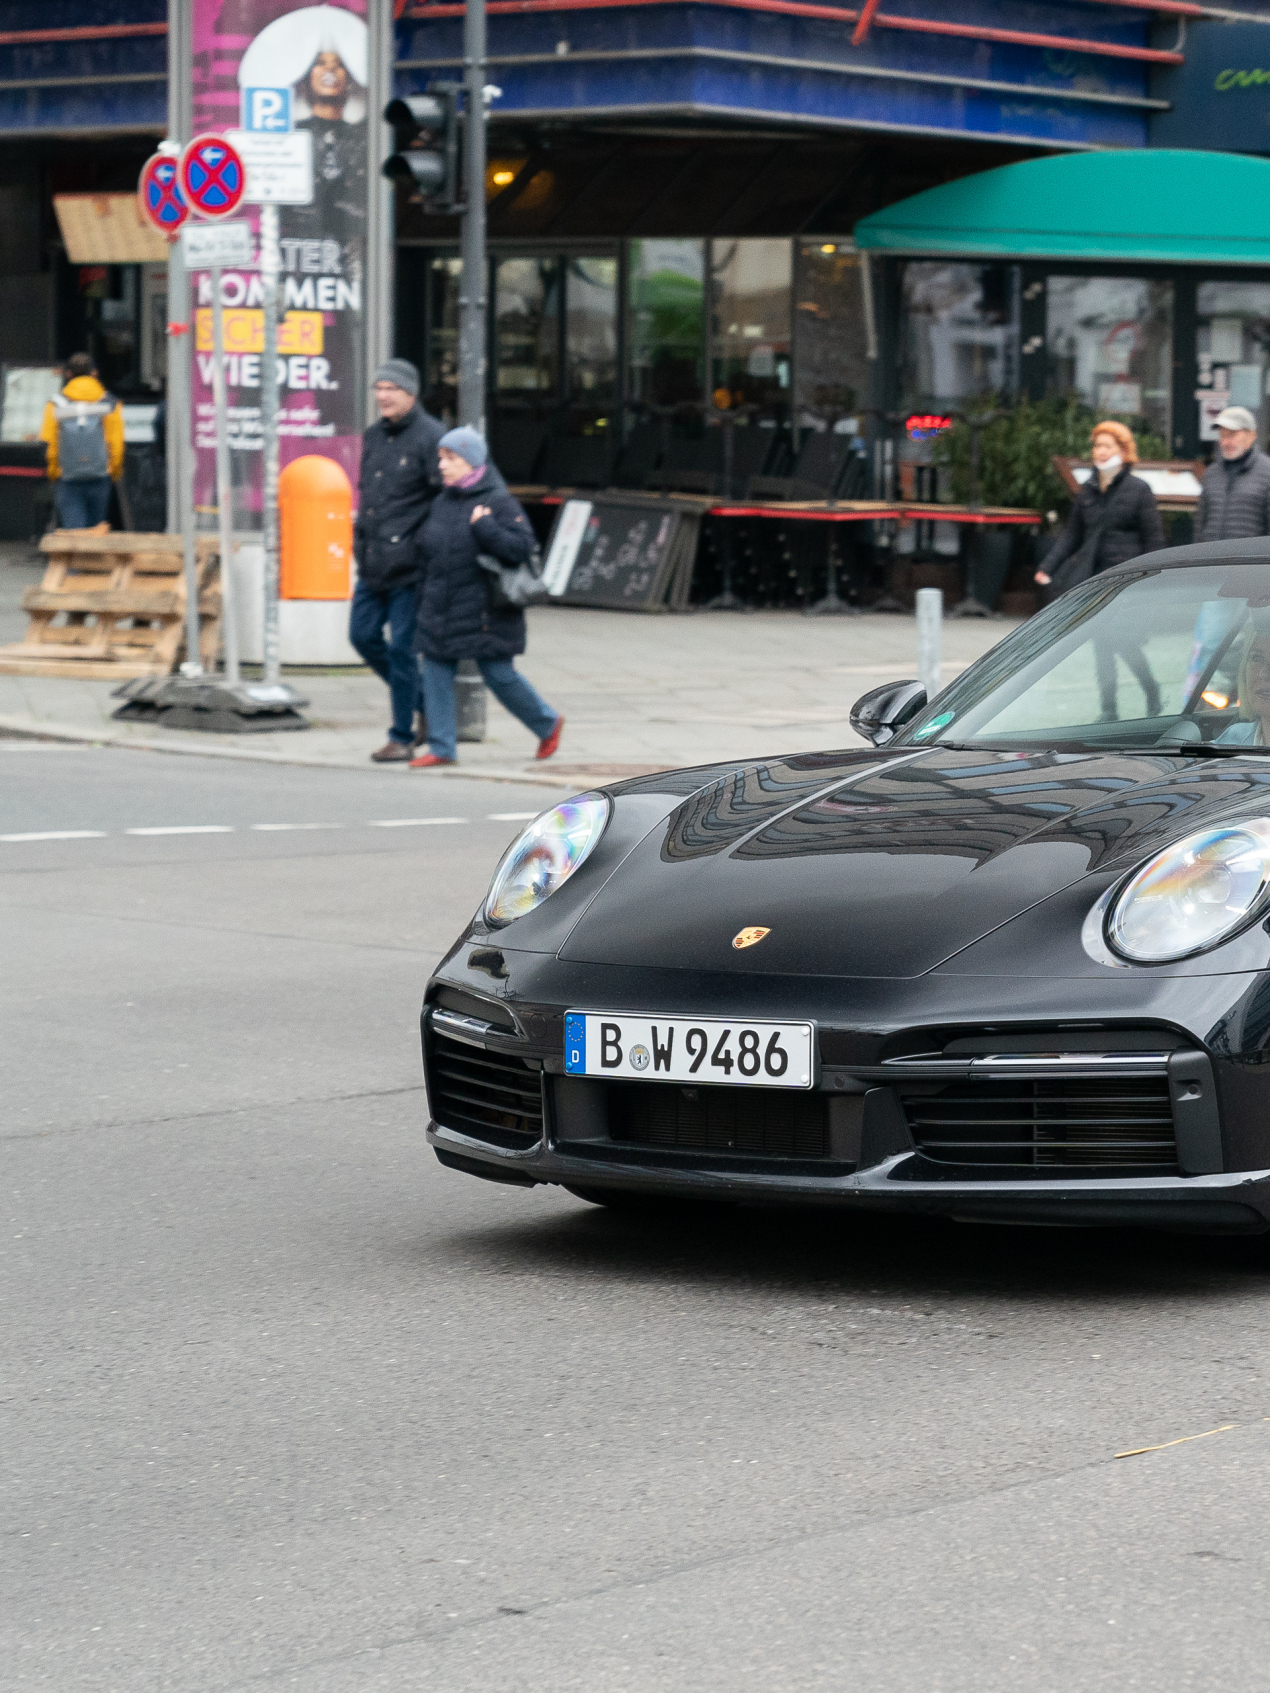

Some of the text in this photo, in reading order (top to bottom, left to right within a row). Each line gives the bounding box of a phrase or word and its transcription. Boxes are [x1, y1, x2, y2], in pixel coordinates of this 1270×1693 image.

[200, 314, 318, 347] SCHER
[571, 1050, 579, 1063] D
[601, 1022, 623, 1068] B
[651, 1026, 674, 1072] W
[685, 1028, 788, 1077] 9486
